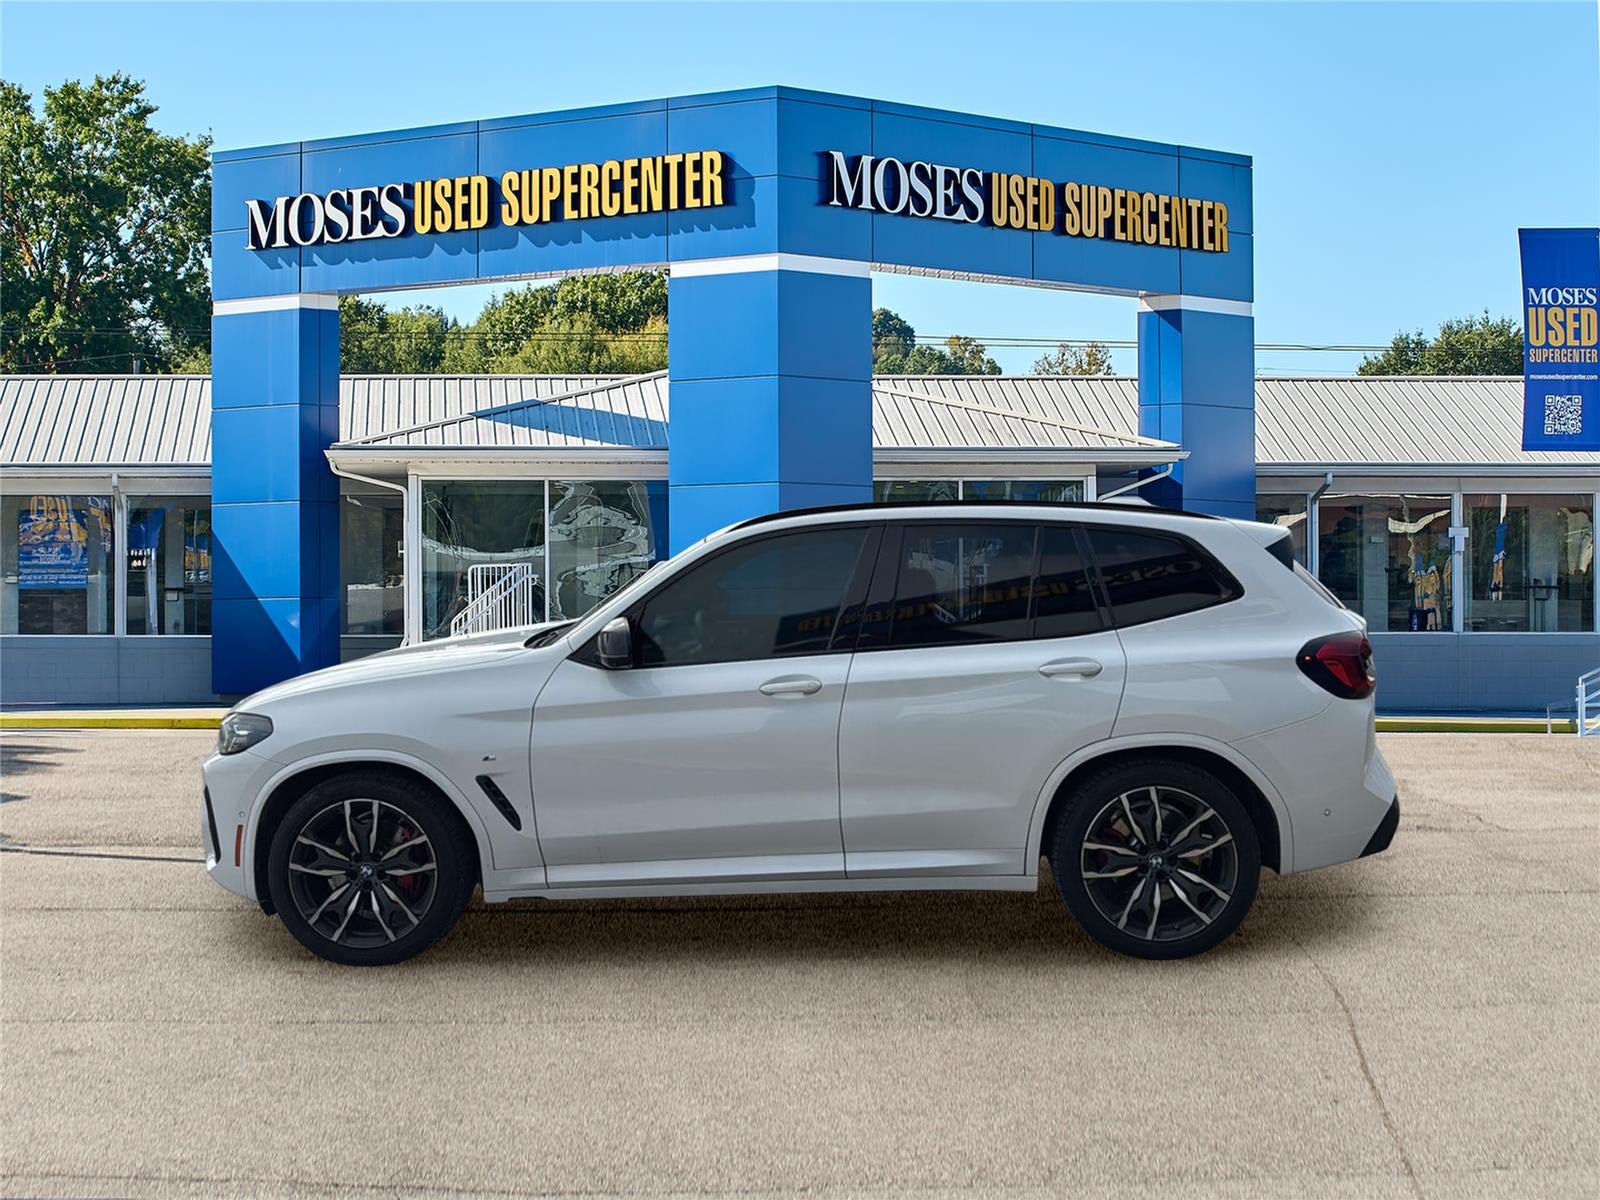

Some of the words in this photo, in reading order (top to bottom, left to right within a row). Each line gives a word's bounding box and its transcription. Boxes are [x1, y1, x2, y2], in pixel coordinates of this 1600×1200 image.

[244, 183, 407, 251] MOSES
[413, 174, 489, 235] USED
[500, 149, 725, 227] SUPERCENTER
[827, 150, 985, 224] MOSES
[991, 172, 1055, 231] USED
[1064, 181, 1230, 252] SUPERCENTER
[1527, 287, 1597, 306] MOSES
[1528, 307, 1598, 347] USED
[1529, 348, 1598, 363] SUPERCENTER
